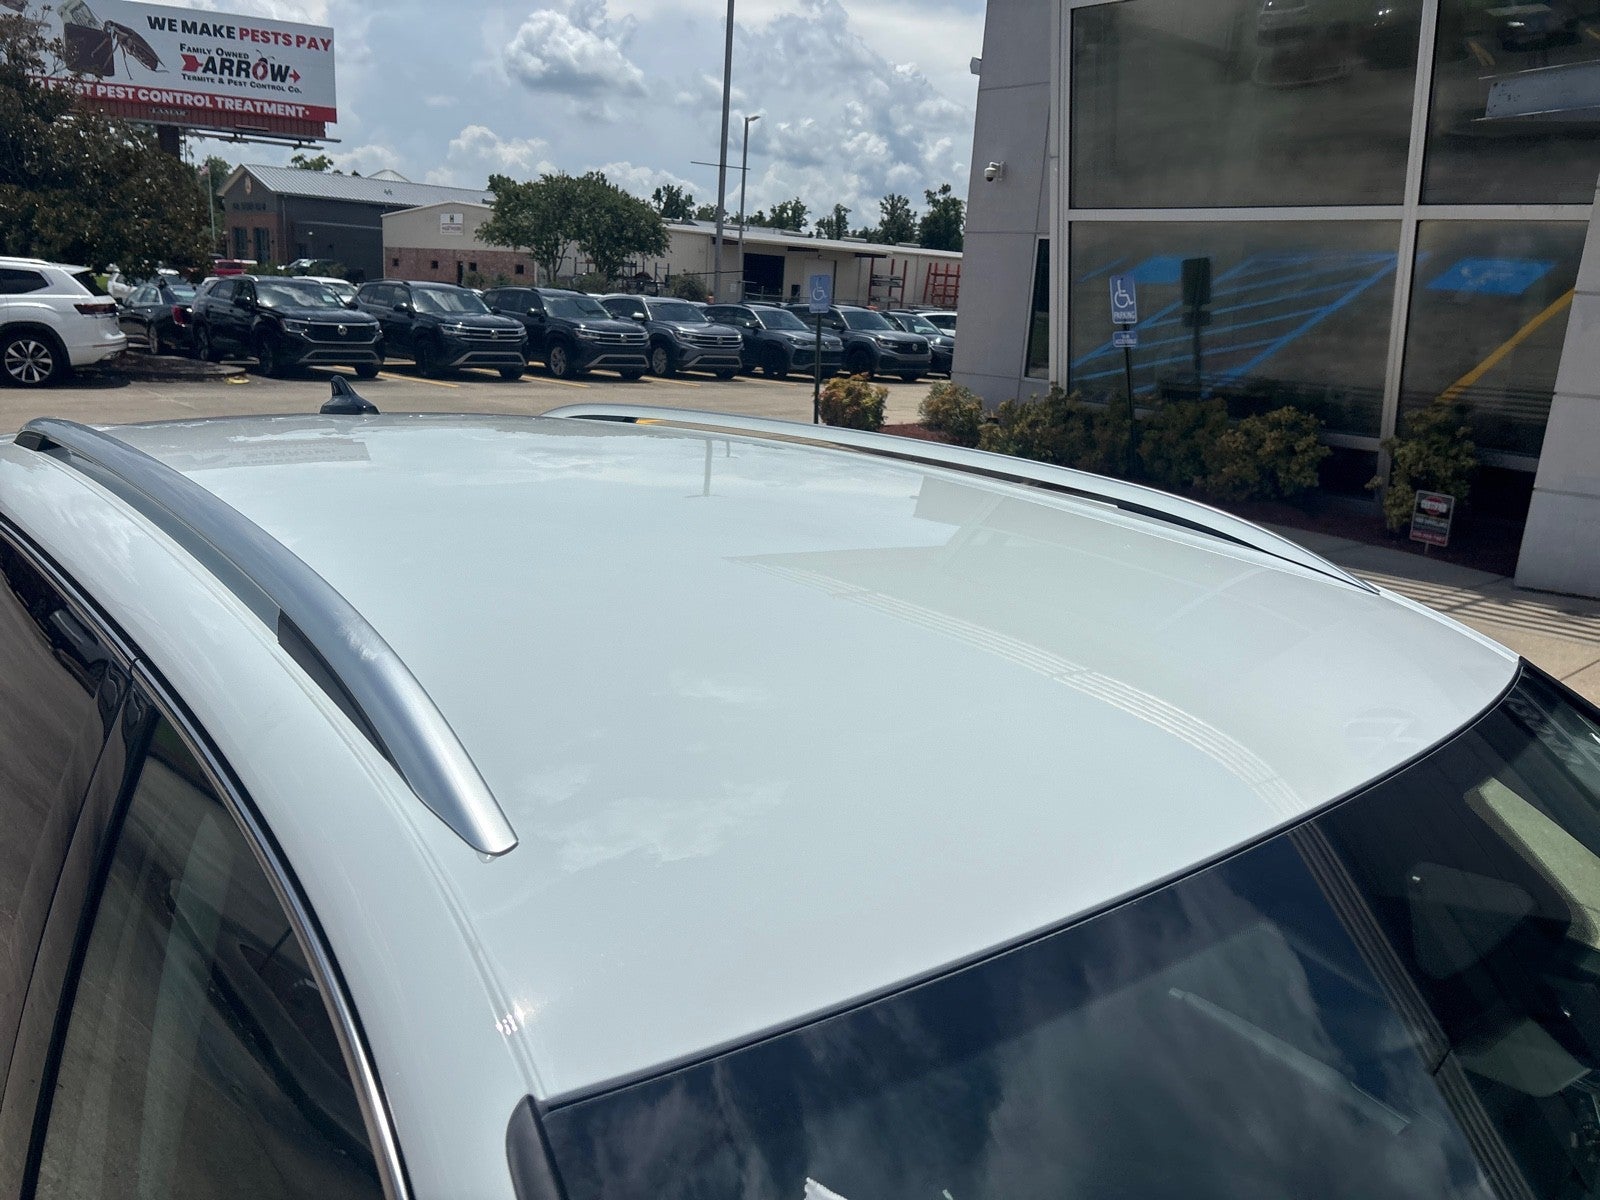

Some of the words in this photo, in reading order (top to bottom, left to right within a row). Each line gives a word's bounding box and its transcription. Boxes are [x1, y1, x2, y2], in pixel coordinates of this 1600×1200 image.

[147, 15, 178, 33] WE
[181, 19, 236, 40] MAKE
[238, 27, 292, 47] PESTS
[295, 34, 332, 52] PAY
[180, 42, 212, 55] FAMILY
[215, 47, 250, 60] OWNED
[202, 55, 290, 83] ARROW
[181, 72, 215, 84] TERMITE
[218, 77, 225, 85] &
[227, 78, 247, 88] PEST
[250, 80, 286, 93] CONTROL
[96, 84, 135, 100] PEST
[137, 88, 213, 108] CONTROL
